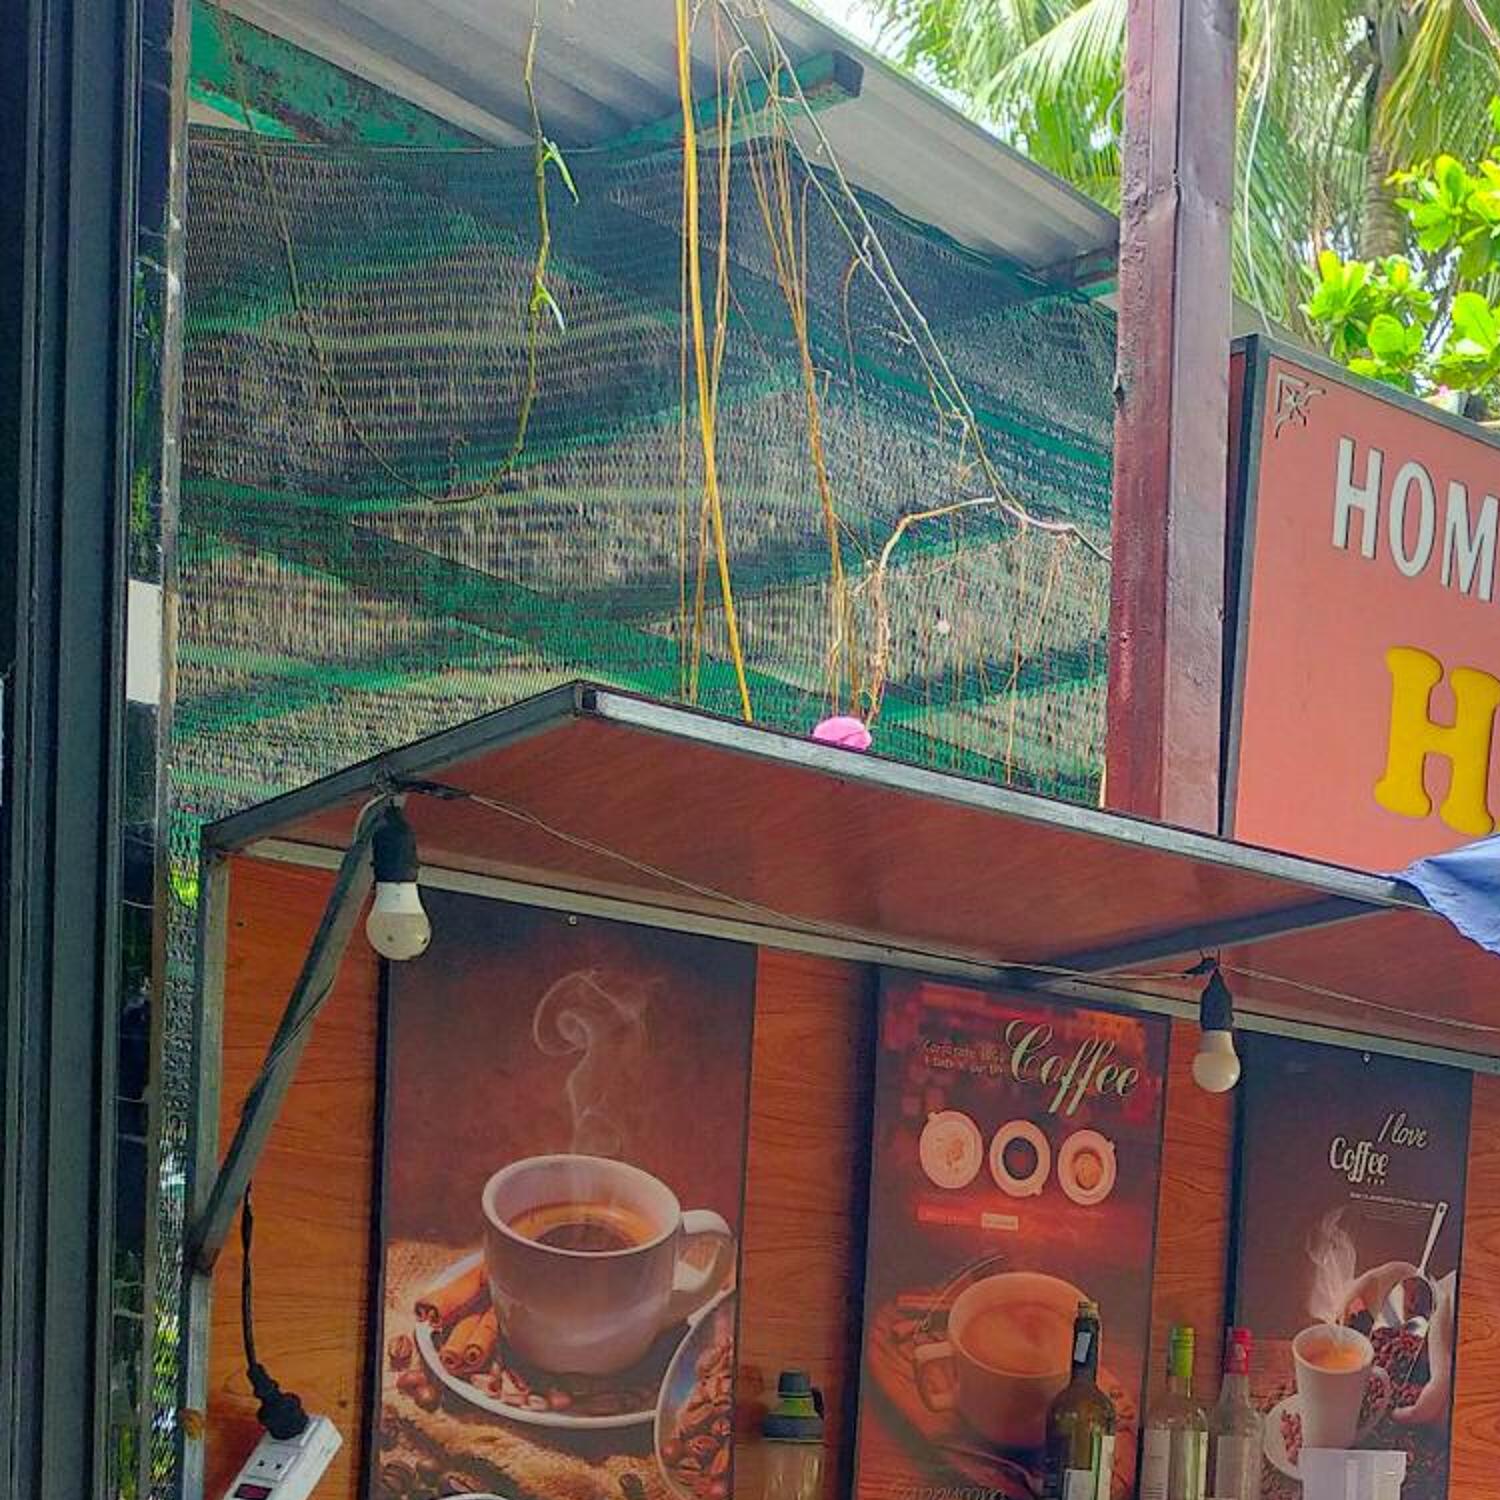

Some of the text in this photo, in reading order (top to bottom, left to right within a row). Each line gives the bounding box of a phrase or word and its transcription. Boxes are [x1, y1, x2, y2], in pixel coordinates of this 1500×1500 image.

[1005, 1019, 1139, 1116] Coffee
[1391, 1112, 1430, 1149] love
[1329, 1137, 1390, 1184] Coffee
